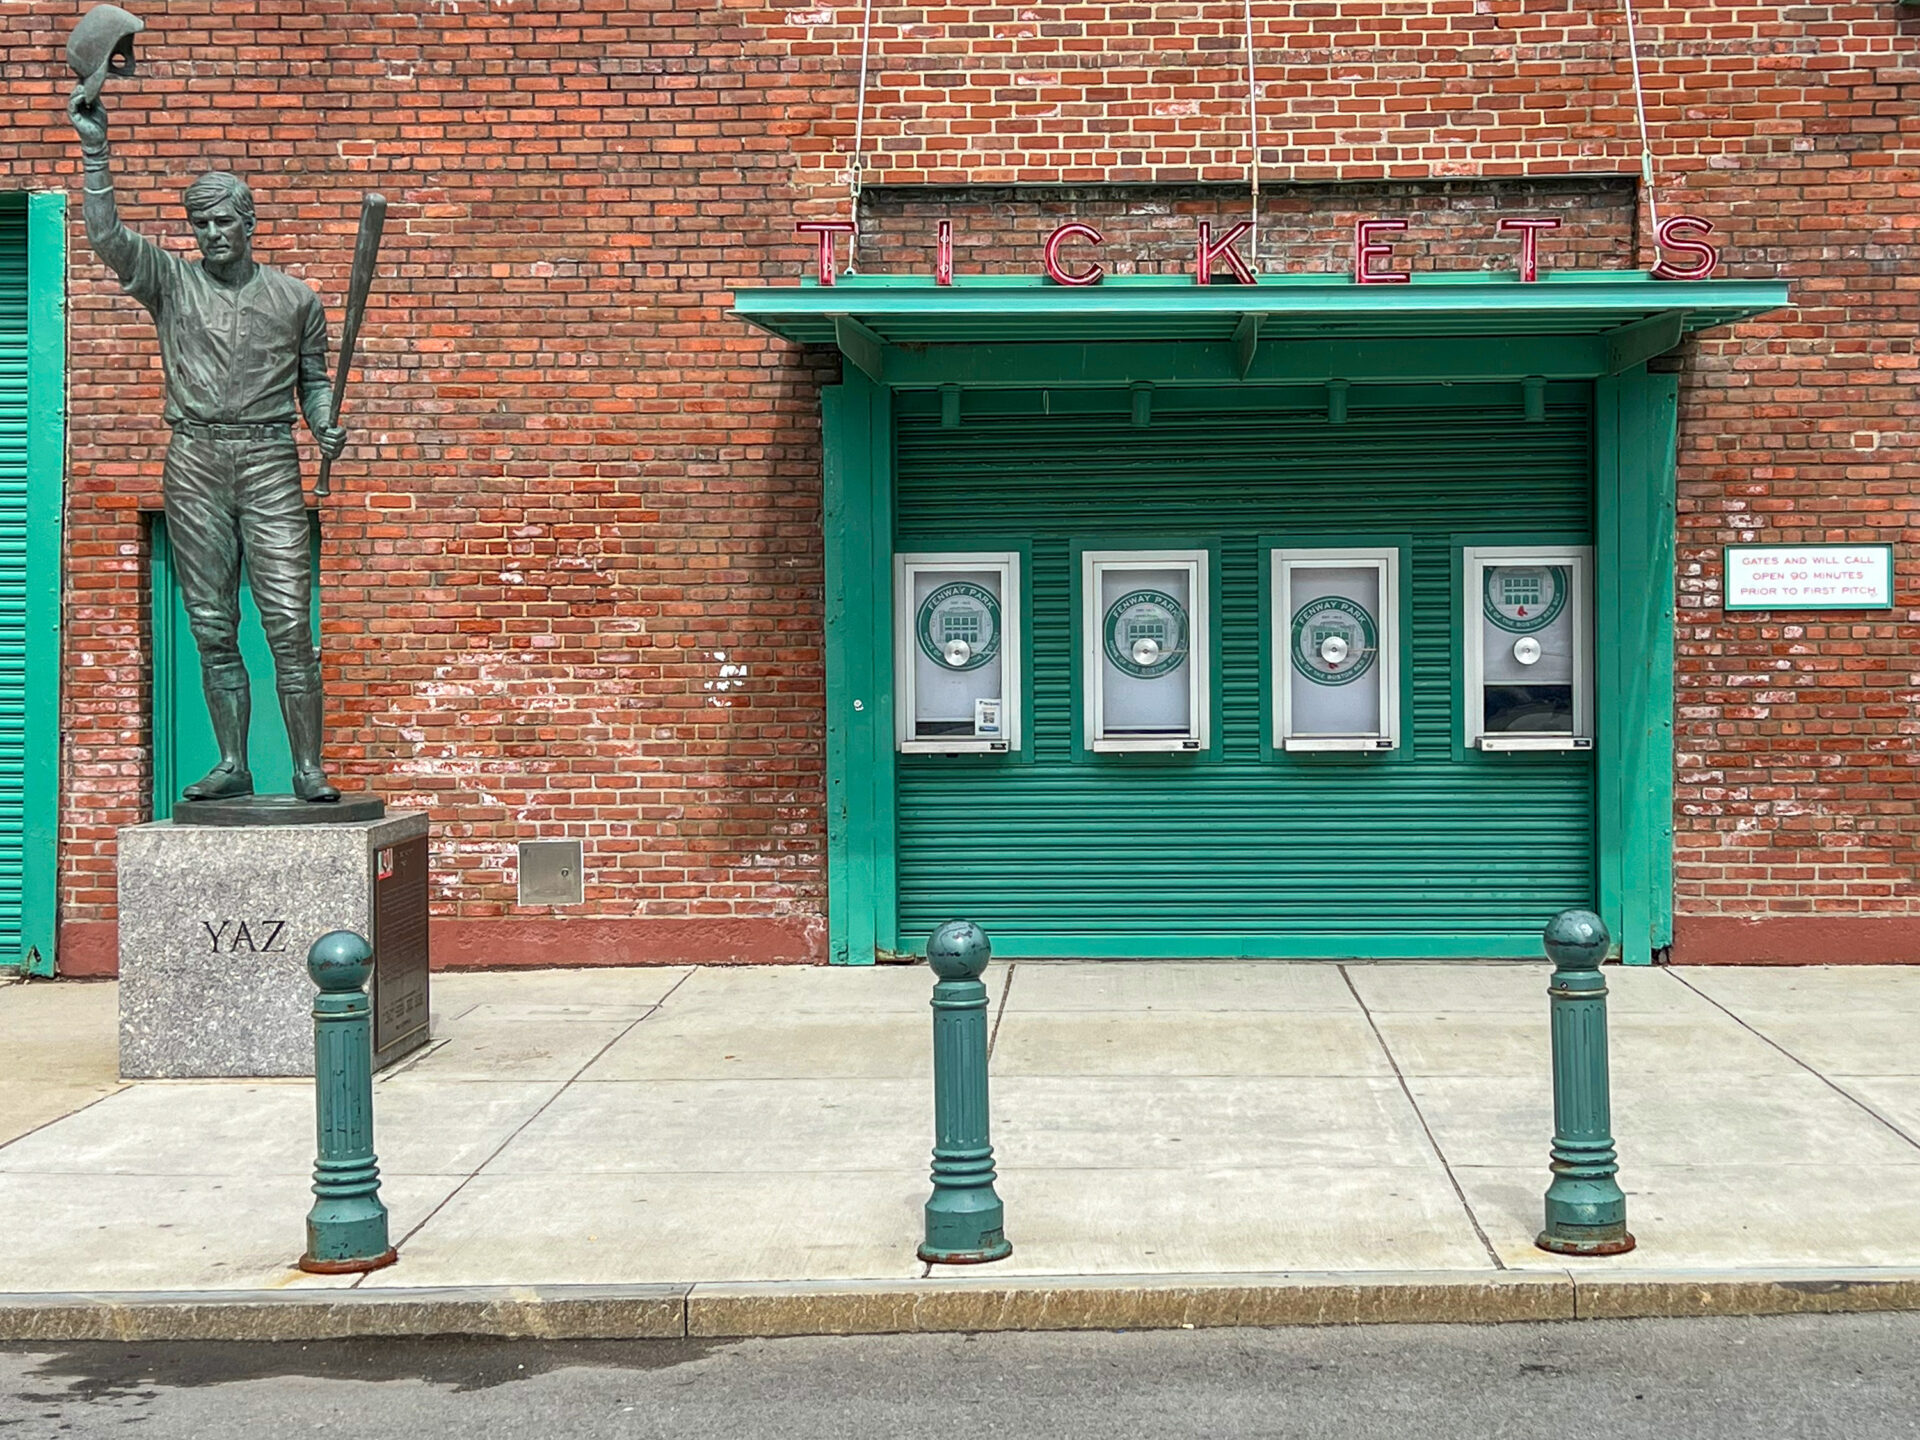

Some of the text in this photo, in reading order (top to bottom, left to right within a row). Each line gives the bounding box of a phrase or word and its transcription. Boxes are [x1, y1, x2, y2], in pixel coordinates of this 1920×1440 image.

[795, 215, 1718, 286] TICKETS
[1742, 556, 1874, 565] GATES AND WILL CALL
[1752, 571, 1864, 581] OPEN 90 MINUTES
[928, 587, 994, 610] FENWAY PARK
[1740, 586, 1876, 596] PRIOR TO FIRST PITCH
[1112, 595, 1179, 618] FENWAY PARK
[1299, 601, 1367, 624] FENWAY PARK
[202, 920, 286, 953] YAZ
